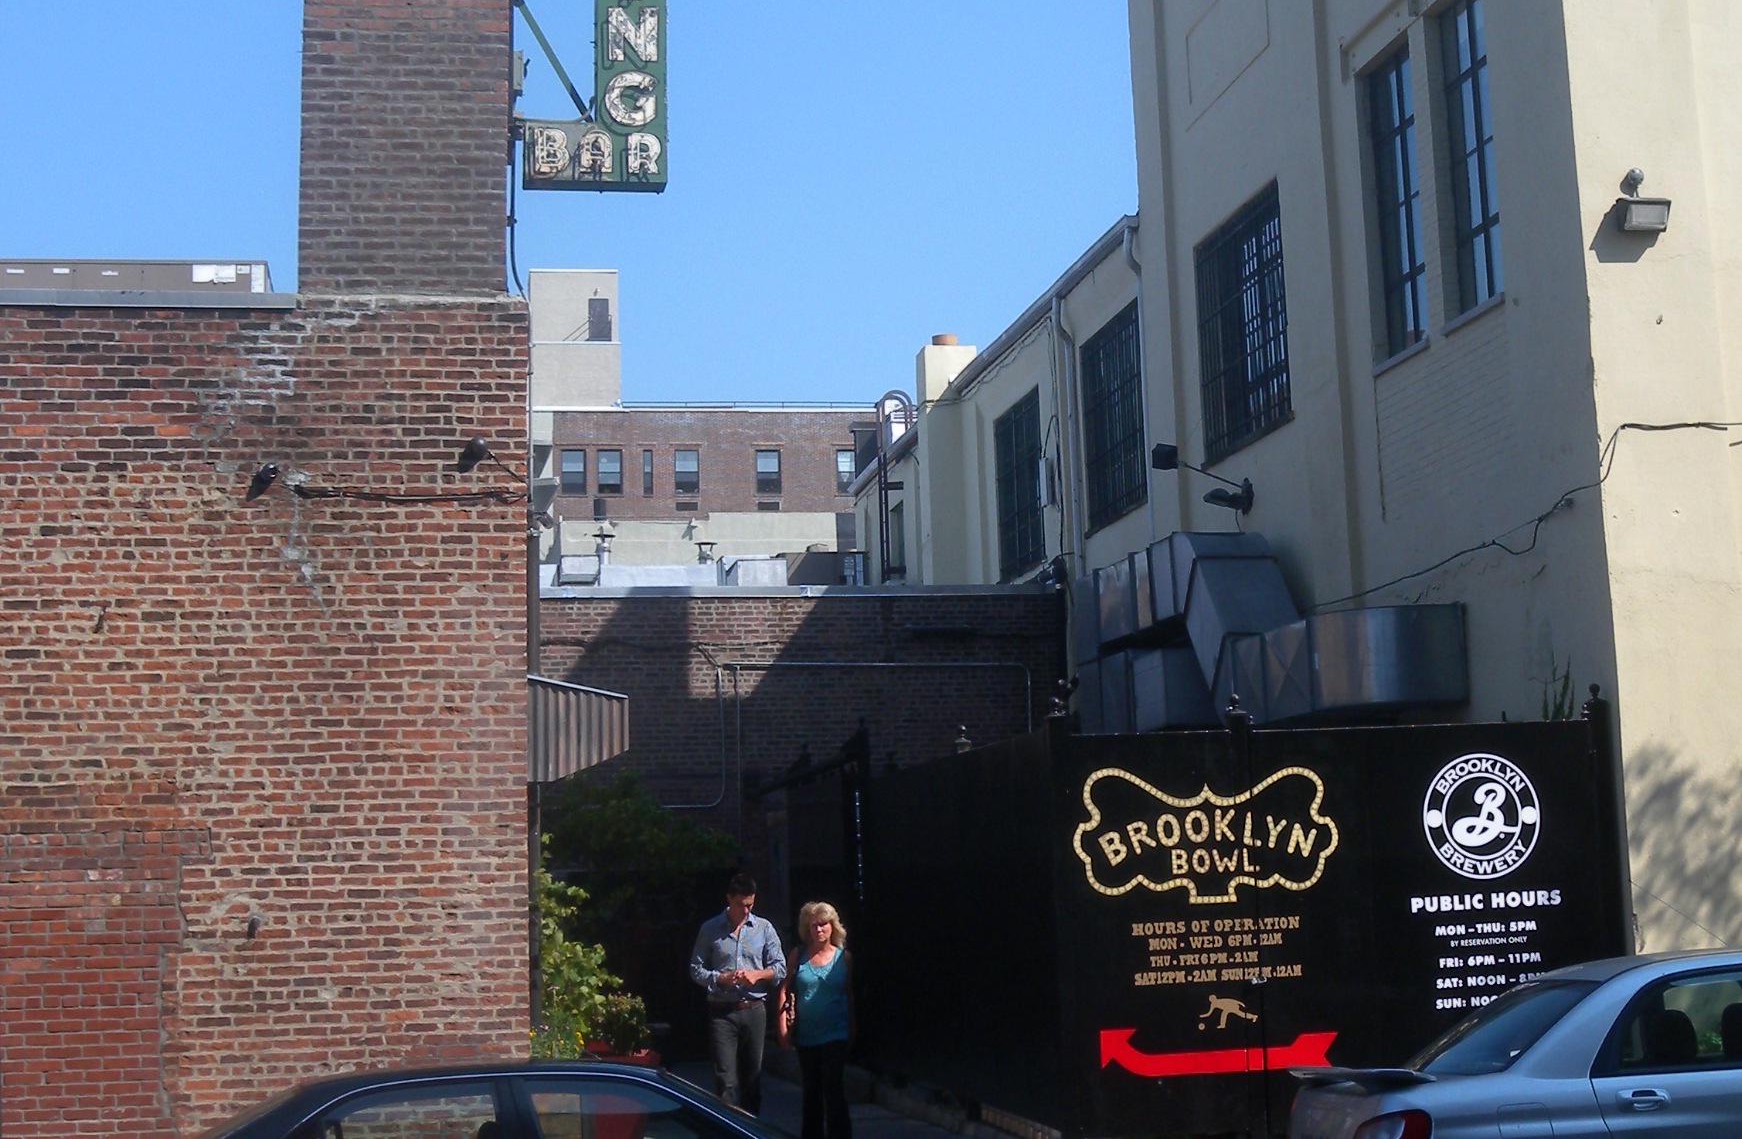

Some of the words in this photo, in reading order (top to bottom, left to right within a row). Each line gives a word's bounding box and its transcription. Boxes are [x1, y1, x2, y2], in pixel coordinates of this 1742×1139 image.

[534, 128, 662, 174] BAR
[1435, 759, 1526, 795] BROOKLYN
[1098, 808, 1317, 867] BROOKLYN
[1171, 848, 1260, 875] BOWL
[1439, 839, 1527, 875] BREWERY
[1411, 894, 1484, 913] PUBLIC
[1491, 889, 1562, 909] HOURS
[1132, 921, 1186, 936] HOURS
[1191, 920, 1210, 933] OF
[1214, 916, 1300, 932] OPERATION
[1509, 920, 1537, 932] 5PM
[1189, 936, 1223, 949] WED
[1460, 937, 1506, 946] RESERVATION
[1508, 936, 1528, 944] ONLY
[1439, 958, 1464, 968] FRI:
[1467, 955, 1495, 966] 6PM
[1508, 952, 1541, 964] 11PM
[1436, 977, 1463, 989] SAT:
[1467, 975, 1506, 987] NOON
[1436, 997, 1466, 1009] SUN:
